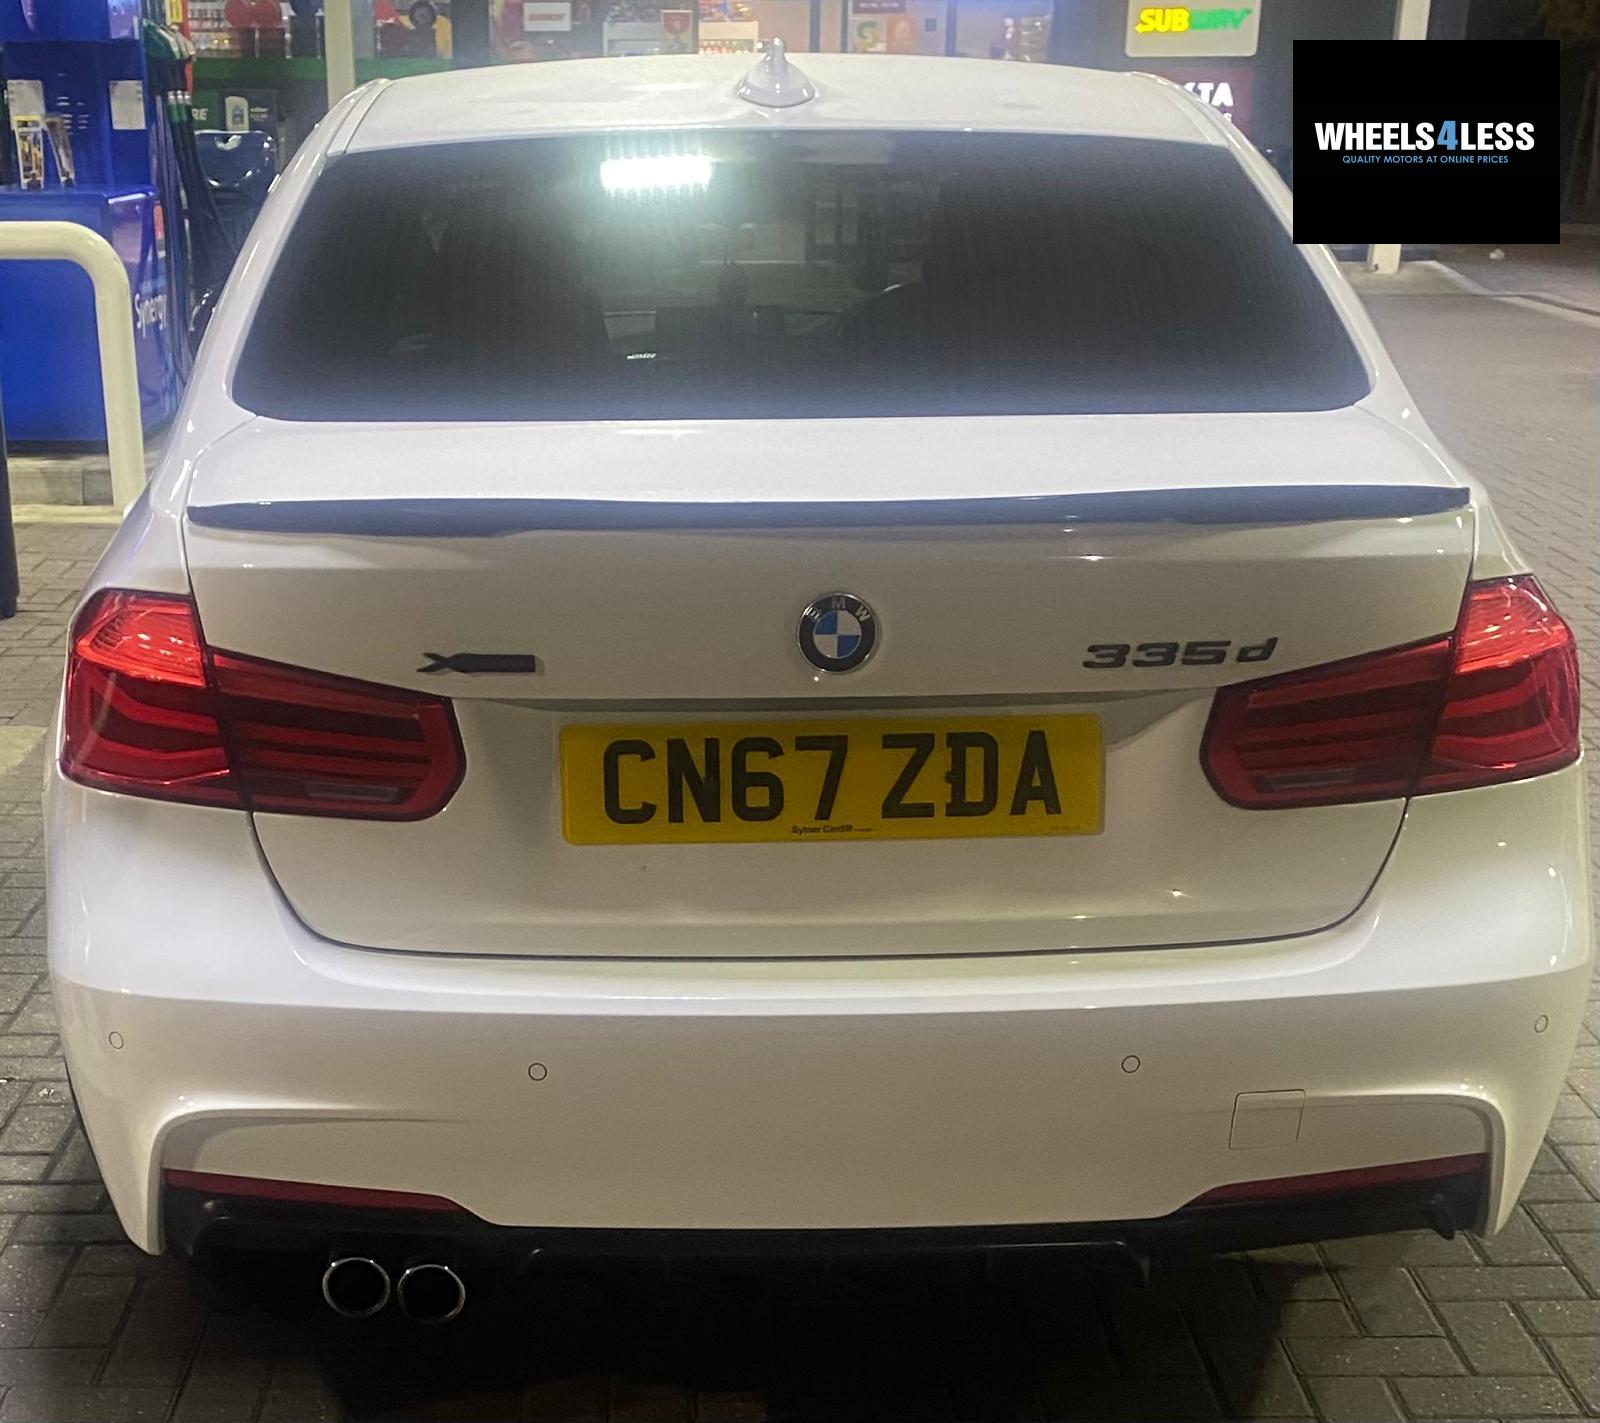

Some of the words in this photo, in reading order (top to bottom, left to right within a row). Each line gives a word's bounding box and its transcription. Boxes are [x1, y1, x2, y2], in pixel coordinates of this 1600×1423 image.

[134, 293, 168, 338] Synergy
[1082, 637, 1279, 668] 335d
[603, 735, 848, 824] CN67
[881, 730, 1062, 818] ZDA
